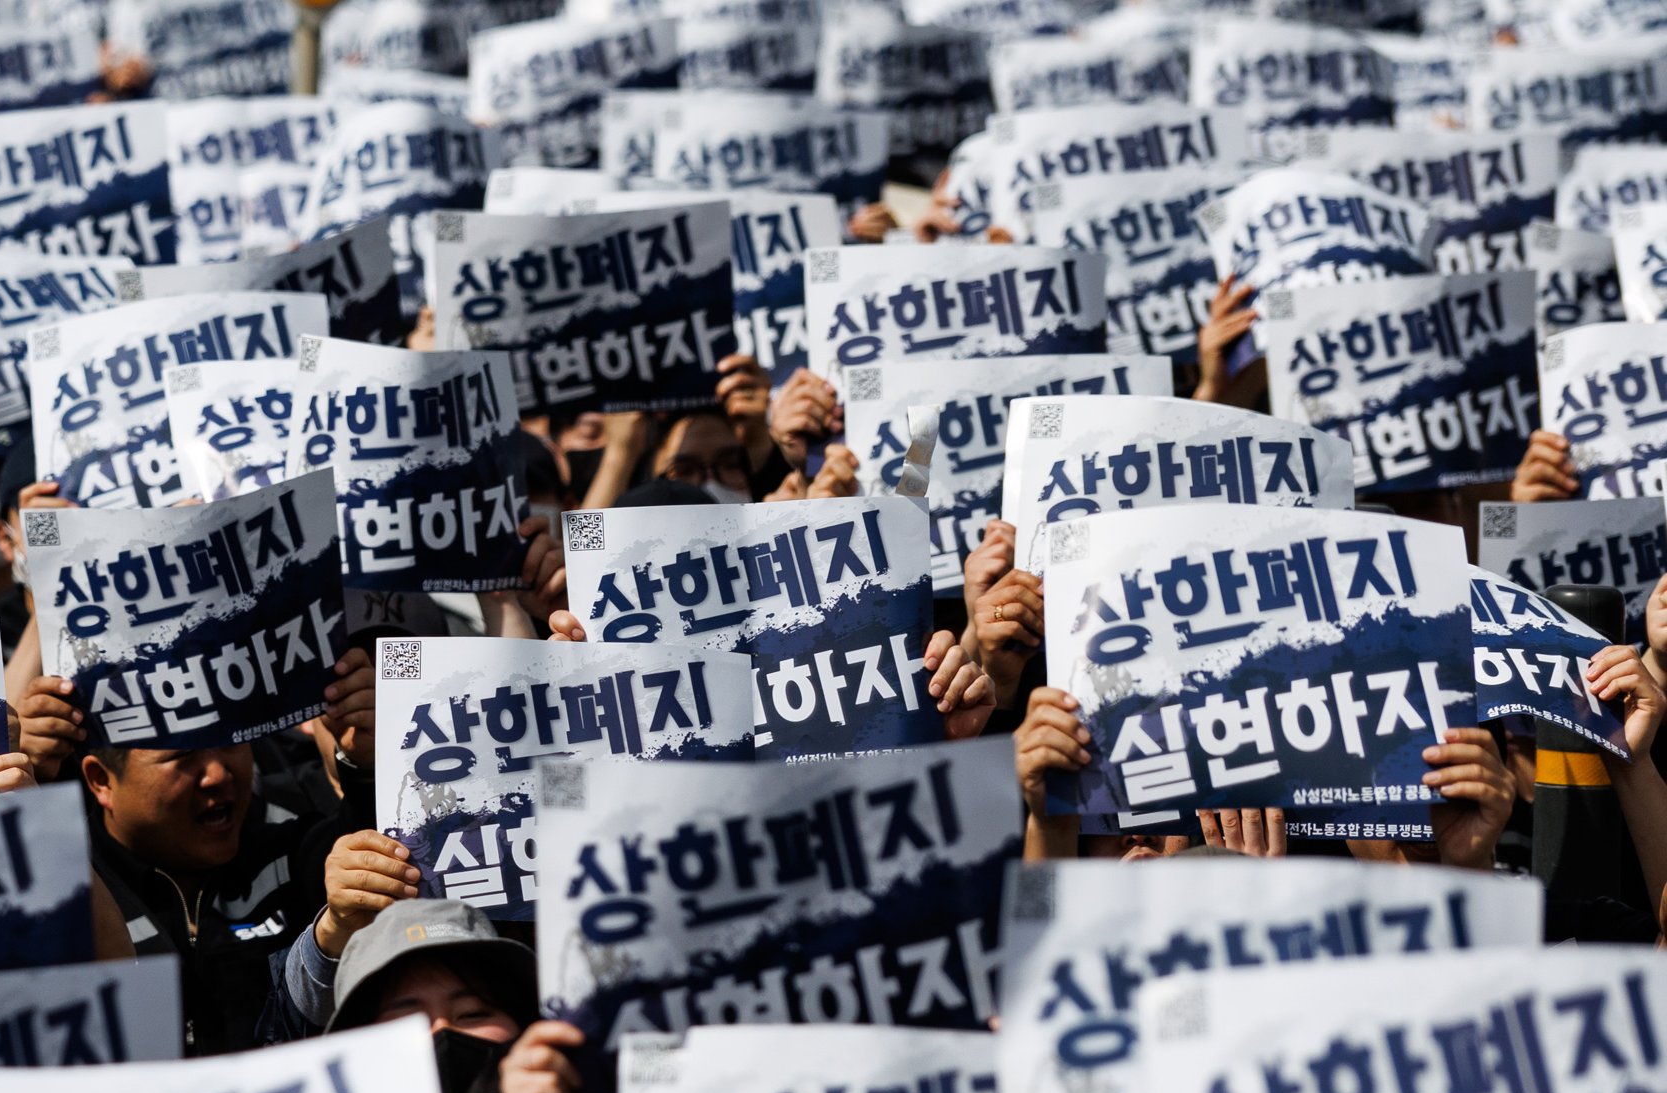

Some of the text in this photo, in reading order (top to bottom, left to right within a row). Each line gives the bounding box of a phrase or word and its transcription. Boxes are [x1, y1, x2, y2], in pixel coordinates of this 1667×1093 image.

[1352, 143, 1525, 210] 한폐지
[455, 214, 697, 327] 상한폐지
[832, 262, 1077, 366] 상한폐지
[53, 303, 293, 433] 상한폐지
[1287, 280, 1507, 396] 상한폐지
[302, 355, 507, 468] 상한폐지
[1558, 358, 1667, 444] 상한
[77, 437, 192, 512] 실현
[341, 472, 529, 580] 현하자
[1038, 437, 1321, 522] 상한폐지
[54, 488, 309, 642] 상한폐지
[589, 509, 891, 645] 상한폐지
[1072, 530, 1419, 664] 상한폐지
[91, 598, 345, 746] 실현하자
[402, 660, 717, 786] 상한폐지
[752, 632, 927, 730] 하자
[1474, 644, 1605, 716] 하자
[1110, 661, 1475, 808] 실현하자
[569, 760, 963, 946] 상한폐지
[1285, 822, 1435, 839] 전자노동조합 공동투쟁본부
